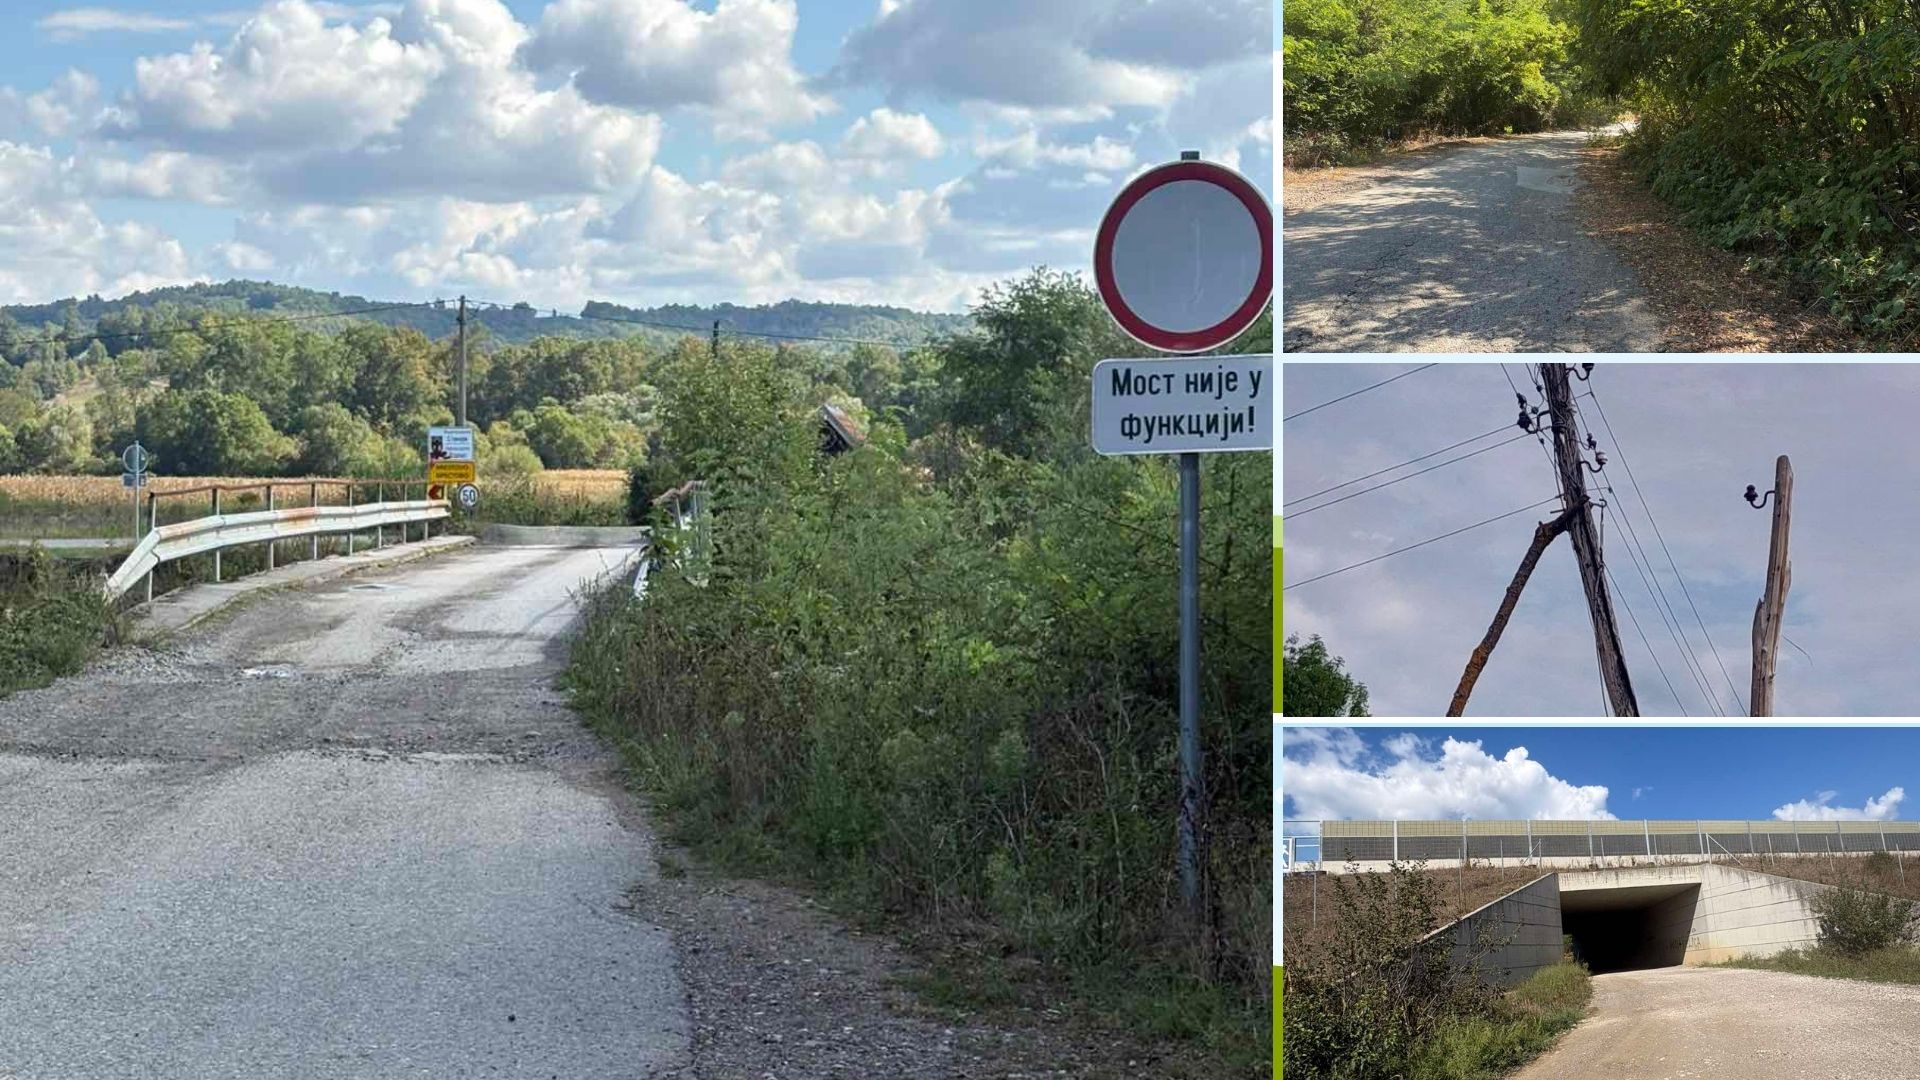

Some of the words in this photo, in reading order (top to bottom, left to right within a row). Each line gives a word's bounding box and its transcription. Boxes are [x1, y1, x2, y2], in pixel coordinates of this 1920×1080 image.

[1112, 368, 1175, 396] Мост
[1185, 365, 1238, 400] није
[1249, 370, 1262, 399] у
[1120, 406, 1255, 444] функцији!
[462, 489, 476, 503] 50
